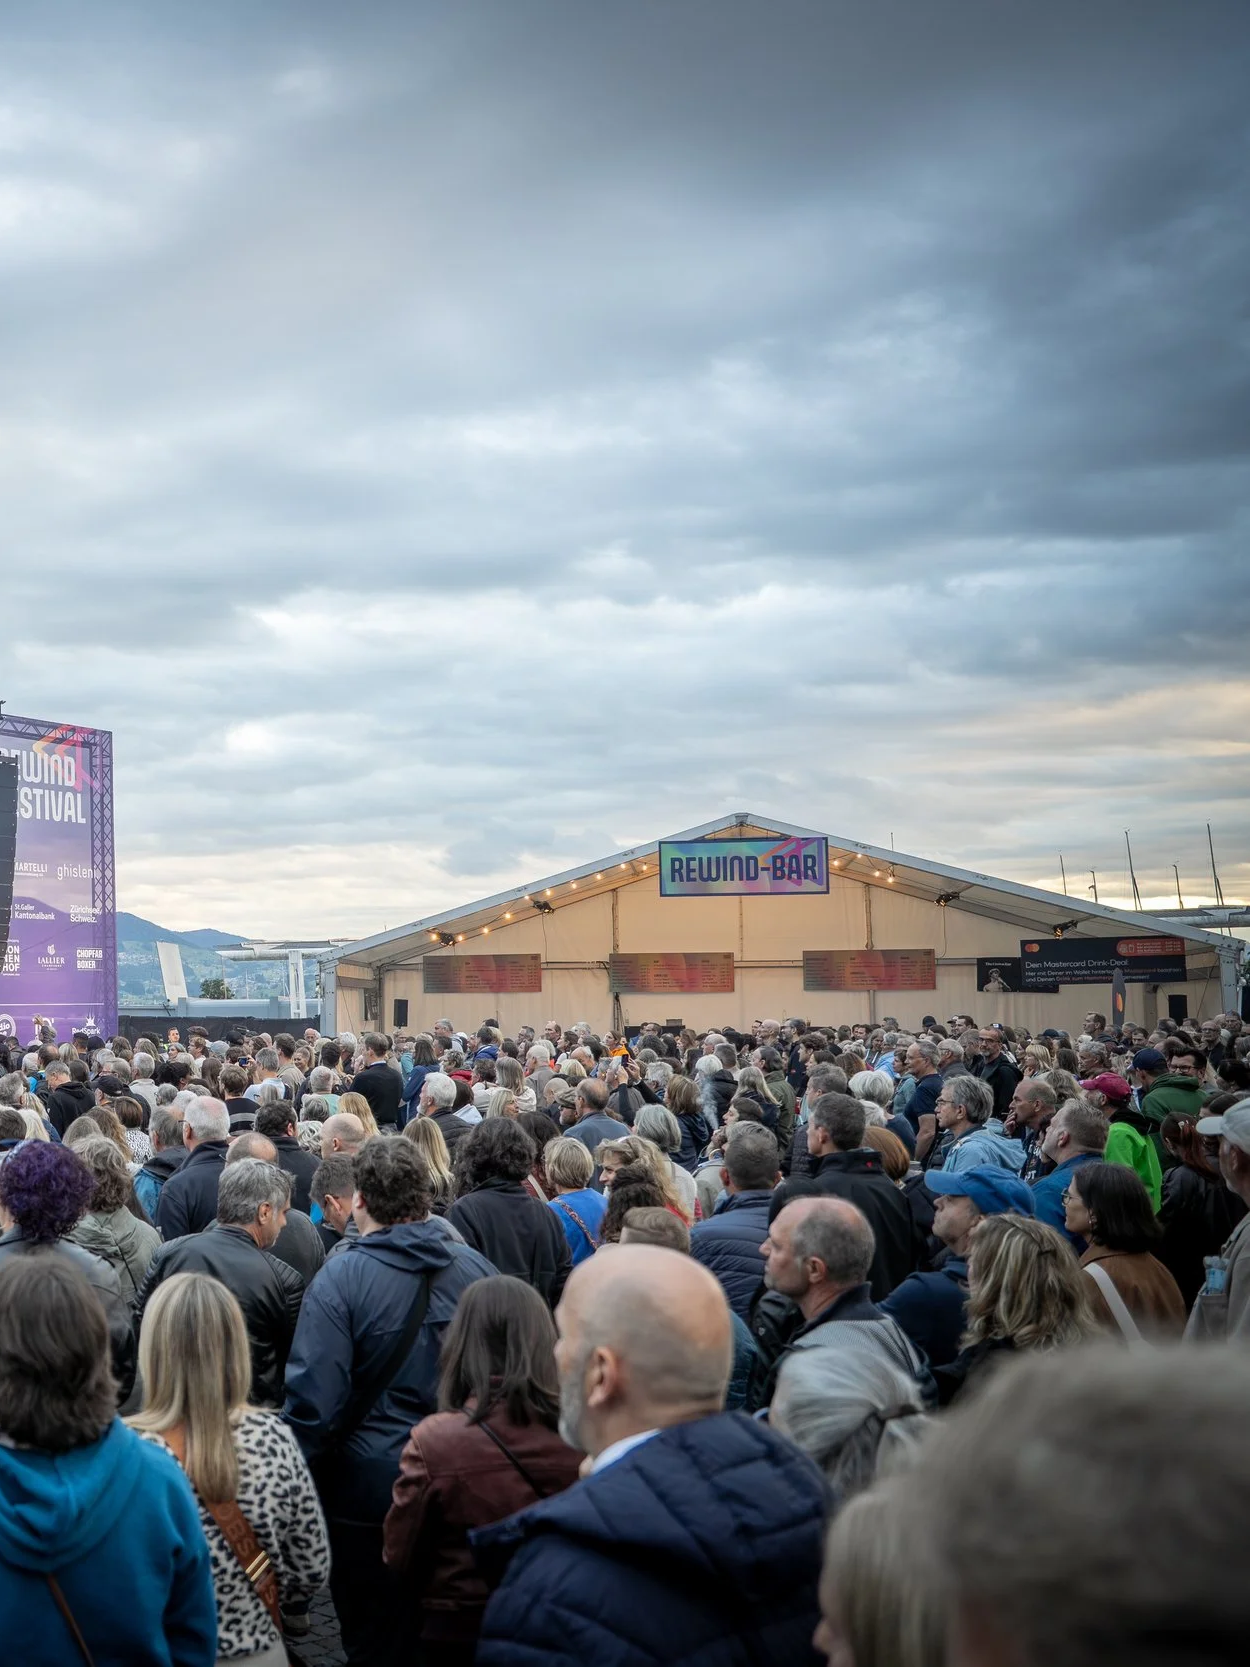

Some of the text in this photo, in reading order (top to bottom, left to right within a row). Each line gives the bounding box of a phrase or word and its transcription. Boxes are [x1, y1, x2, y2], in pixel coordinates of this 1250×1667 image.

[17, 787, 87, 824] STIVAL
[670, 853, 818, 883] REWIND-BAR
[14, 911, 56, 920] Kantonalbank
[77, 949, 103, 959] CHOPFAB
[1044, 960, 1086, 968] Mastercard
